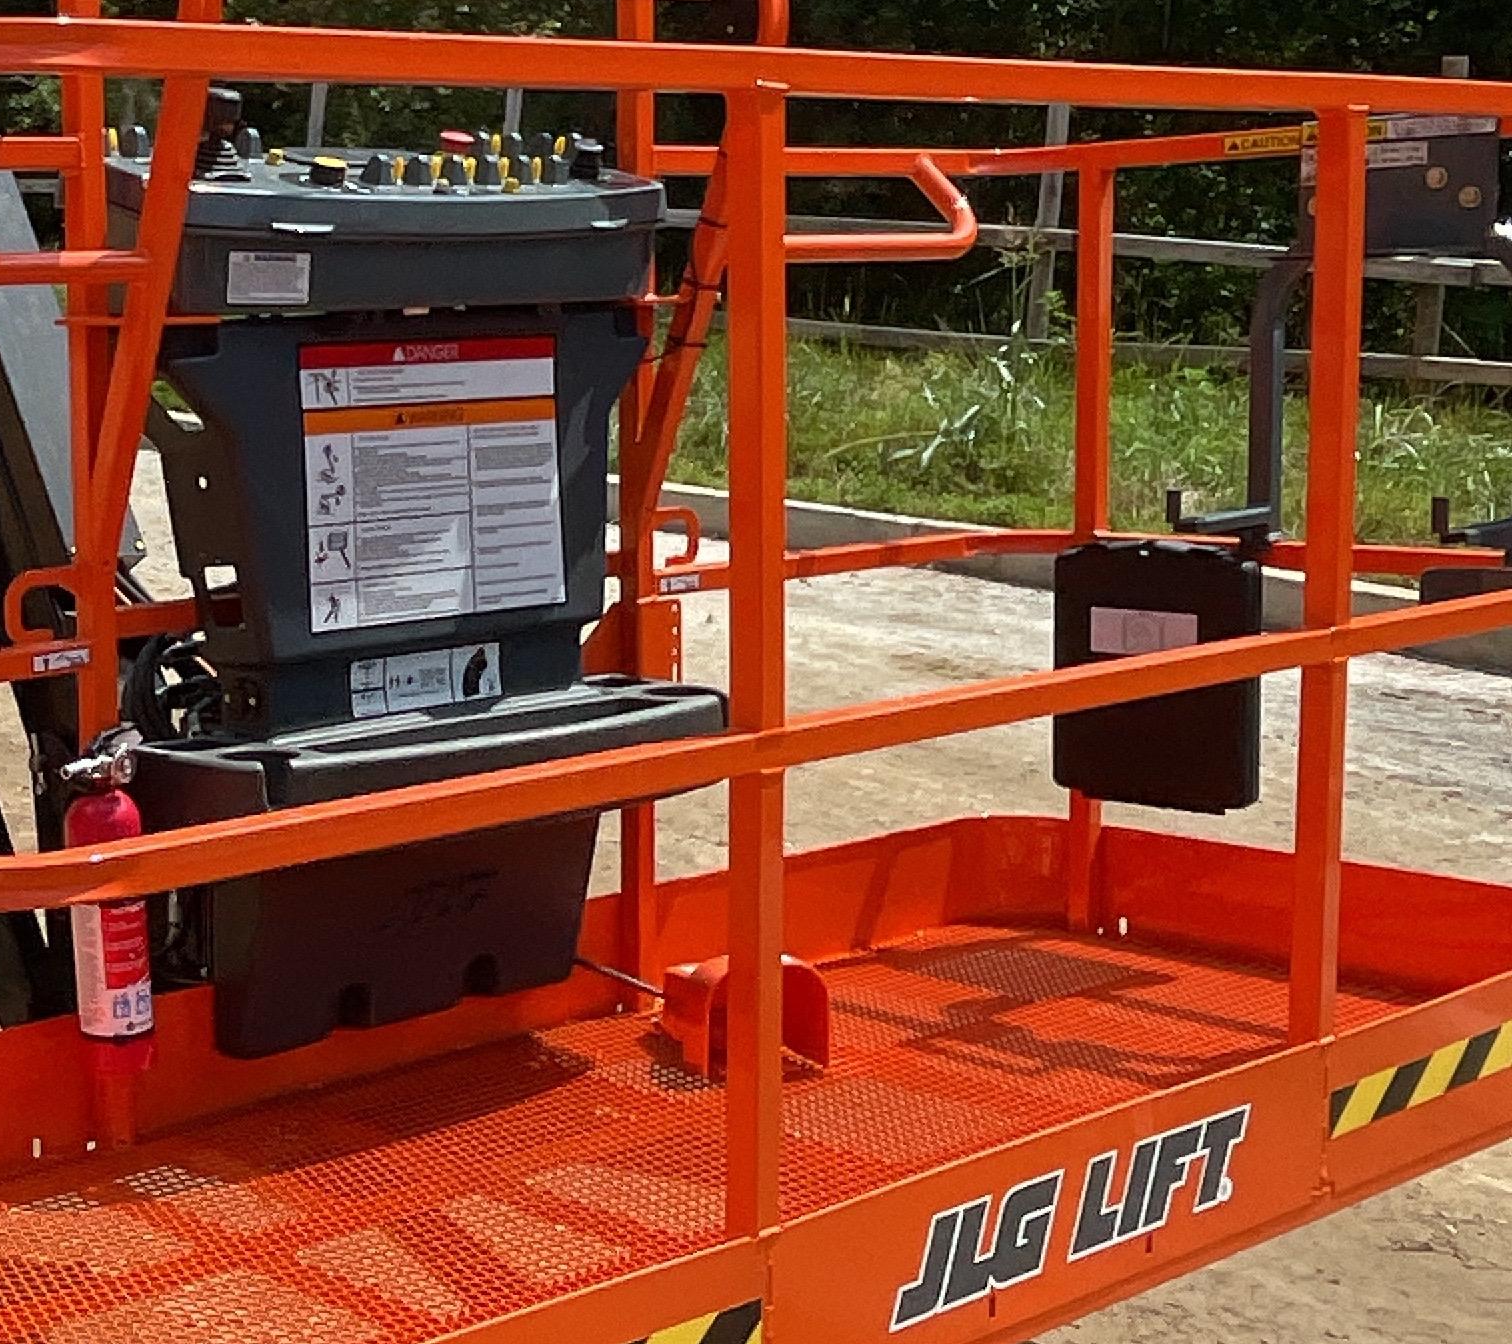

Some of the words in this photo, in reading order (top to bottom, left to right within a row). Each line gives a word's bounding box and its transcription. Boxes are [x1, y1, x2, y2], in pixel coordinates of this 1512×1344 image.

[406, 343, 460, 362] DANGER
[889, 1168, 1065, 1333] JLG
[1067, 1103, 1252, 1263] LIFT
